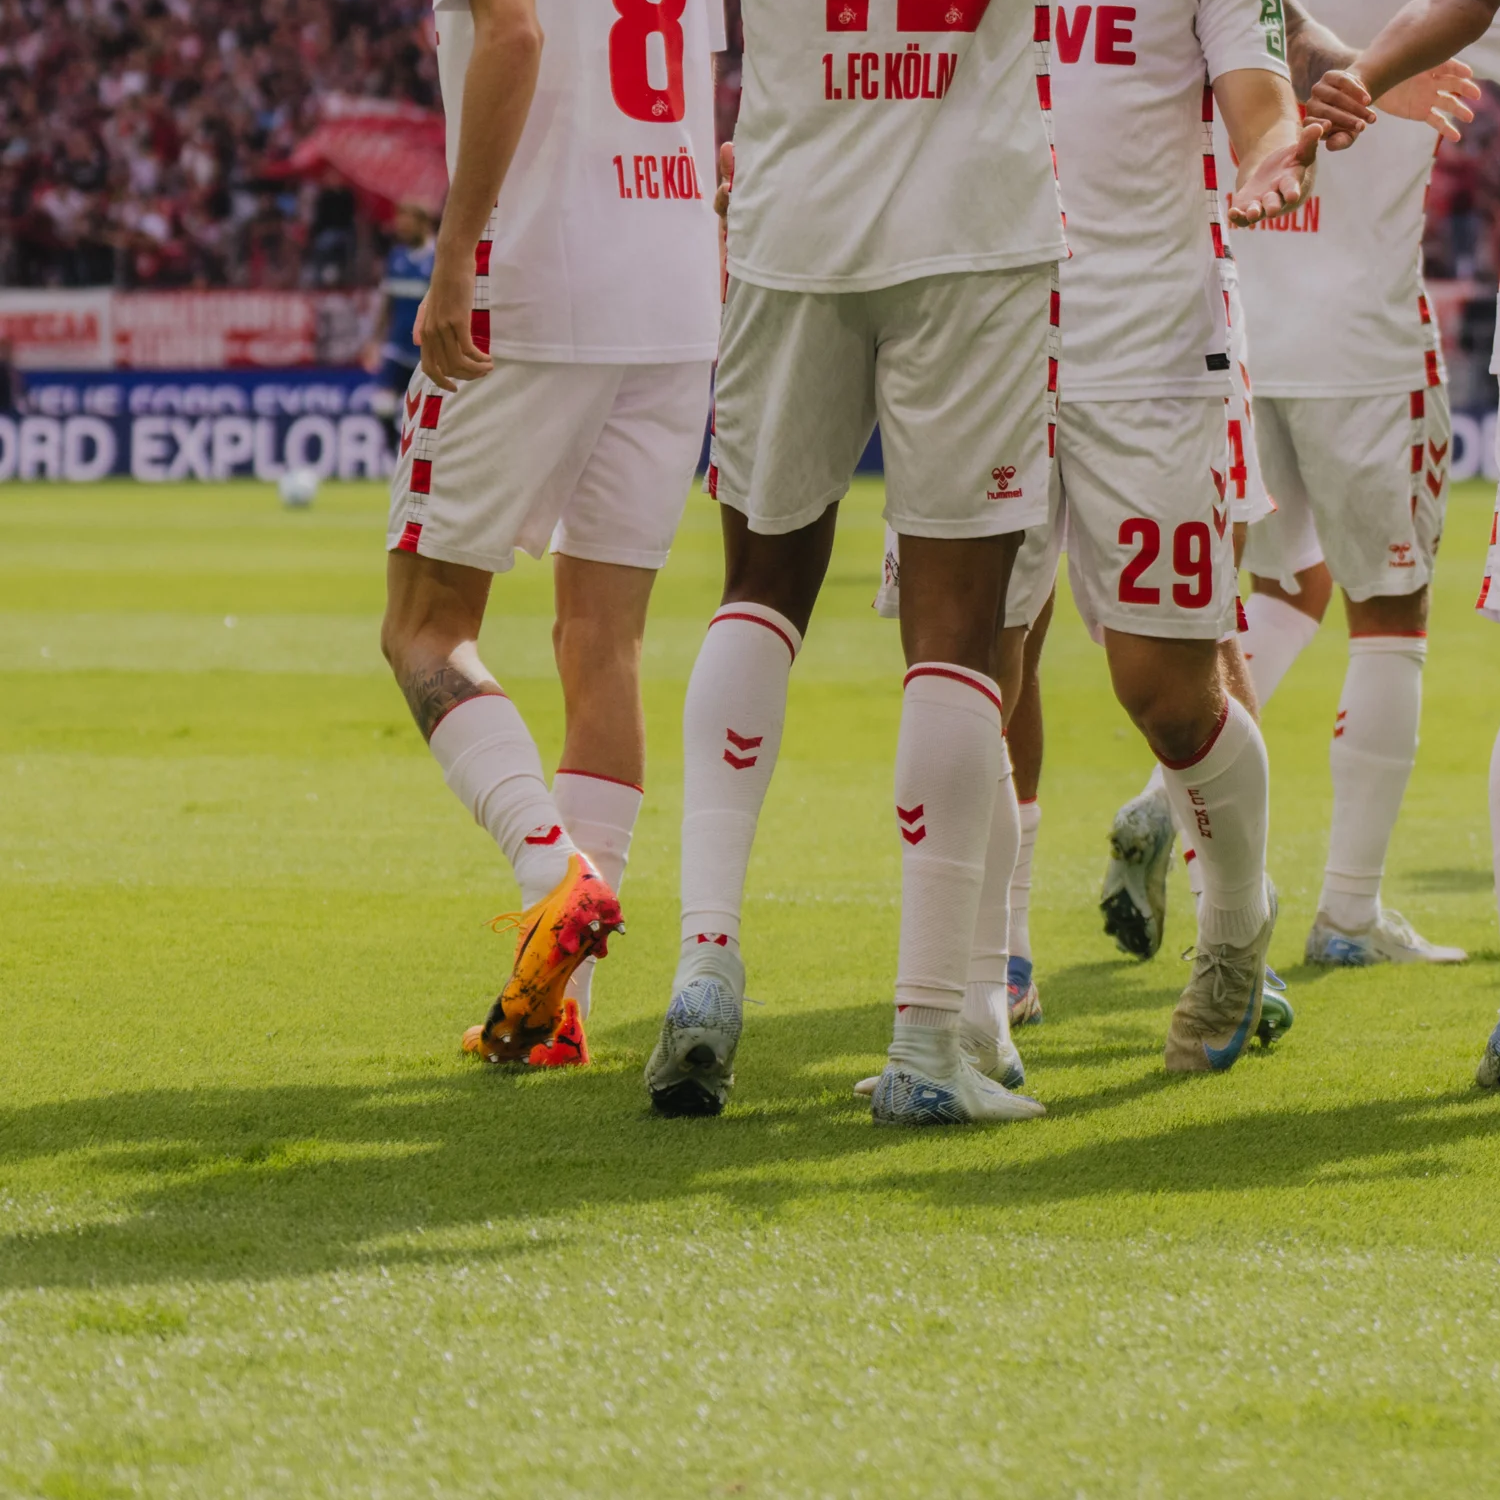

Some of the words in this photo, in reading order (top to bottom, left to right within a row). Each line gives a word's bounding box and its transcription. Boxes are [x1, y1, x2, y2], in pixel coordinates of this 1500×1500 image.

[822, 52, 843, 100] 1.
[848, 53, 879, 100] FC
[885, 43, 957, 100] KÖLN
[612, 155, 633, 199] 1.
[633, 155, 660, 199] FC
[130, 416, 394, 482] EXPLOR
[987, 488, 1023, 500] hummel
[1118, 517, 1212, 609] 29
